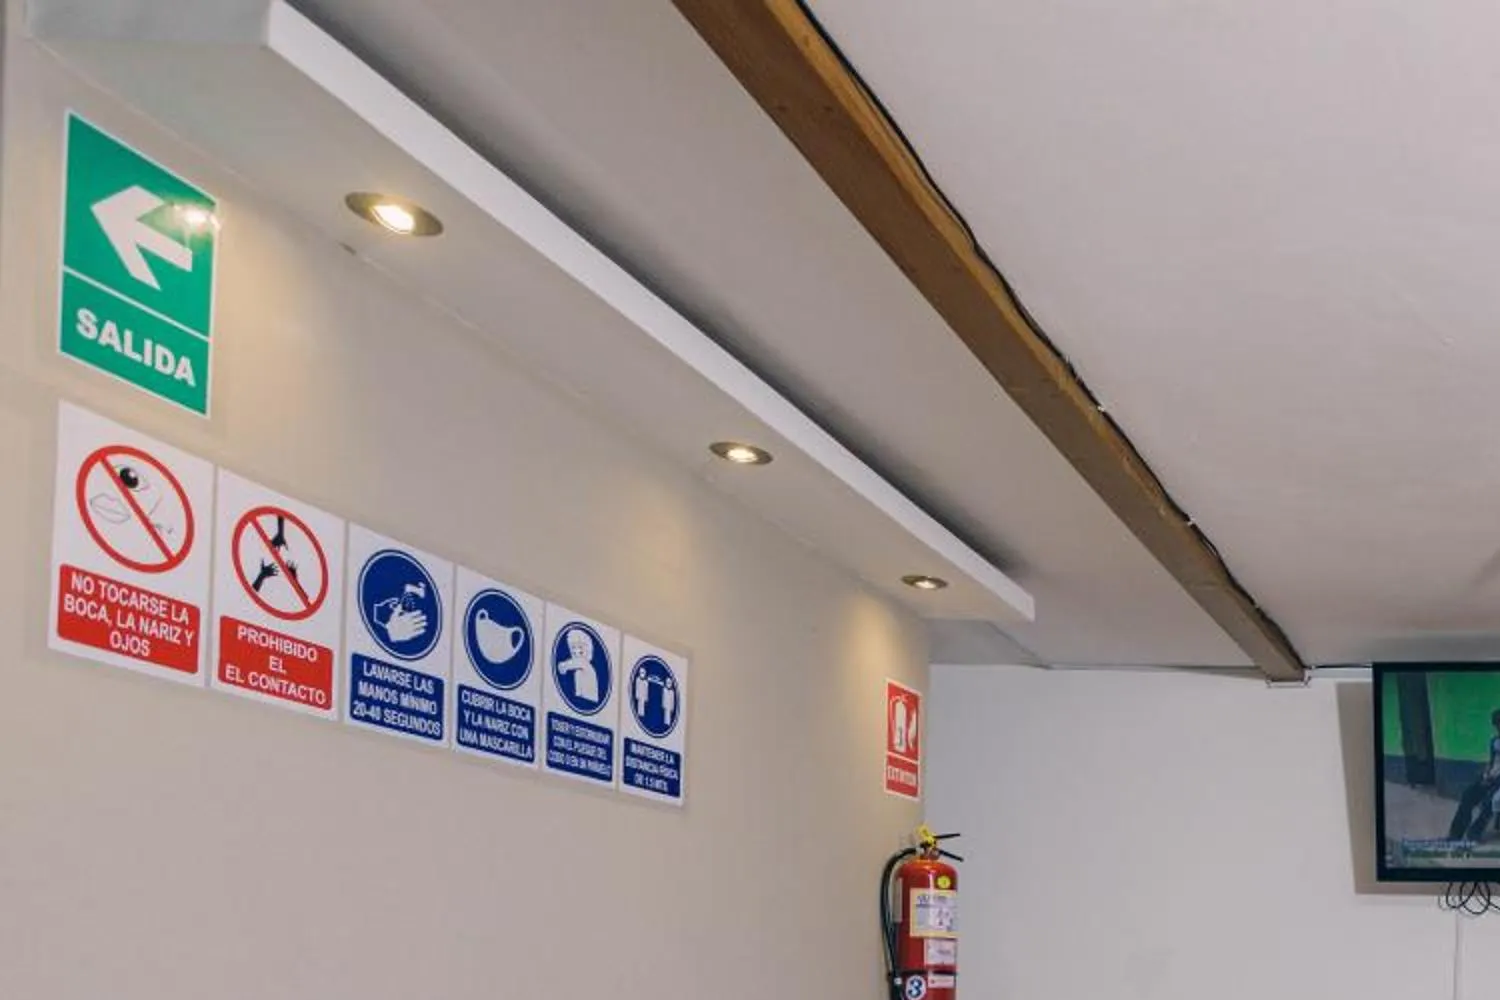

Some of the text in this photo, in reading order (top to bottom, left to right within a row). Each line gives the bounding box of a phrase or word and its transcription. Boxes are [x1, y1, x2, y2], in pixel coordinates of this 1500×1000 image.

[76, 307, 196, 386] SALIDA
[70, 571, 189, 624] NO TOCARSE LA
[64, 595, 193, 647] BOCA, LA NARIZ Y
[110, 631, 150, 657] OJOS
[237, 624, 318, 662] PROHIBIDO
[269, 656, 287, 674] EL
[363, 660, 435, 695] LAVARSE LAS
[225, 664, 326, 705] EL CONTACTO
[358, 680, 398, 705] MANOS
[383, 708, 441, 736] SEGUNDOS
[464, 708, 471, 725] Y
[471, 711, 482, 727] LA
[495, 699, 506, 714] LA
[508, 703, 531, 721] BOCA
[480, 731, 532, 759] MASCARILLA
[908, 979, 923, 998] 3
